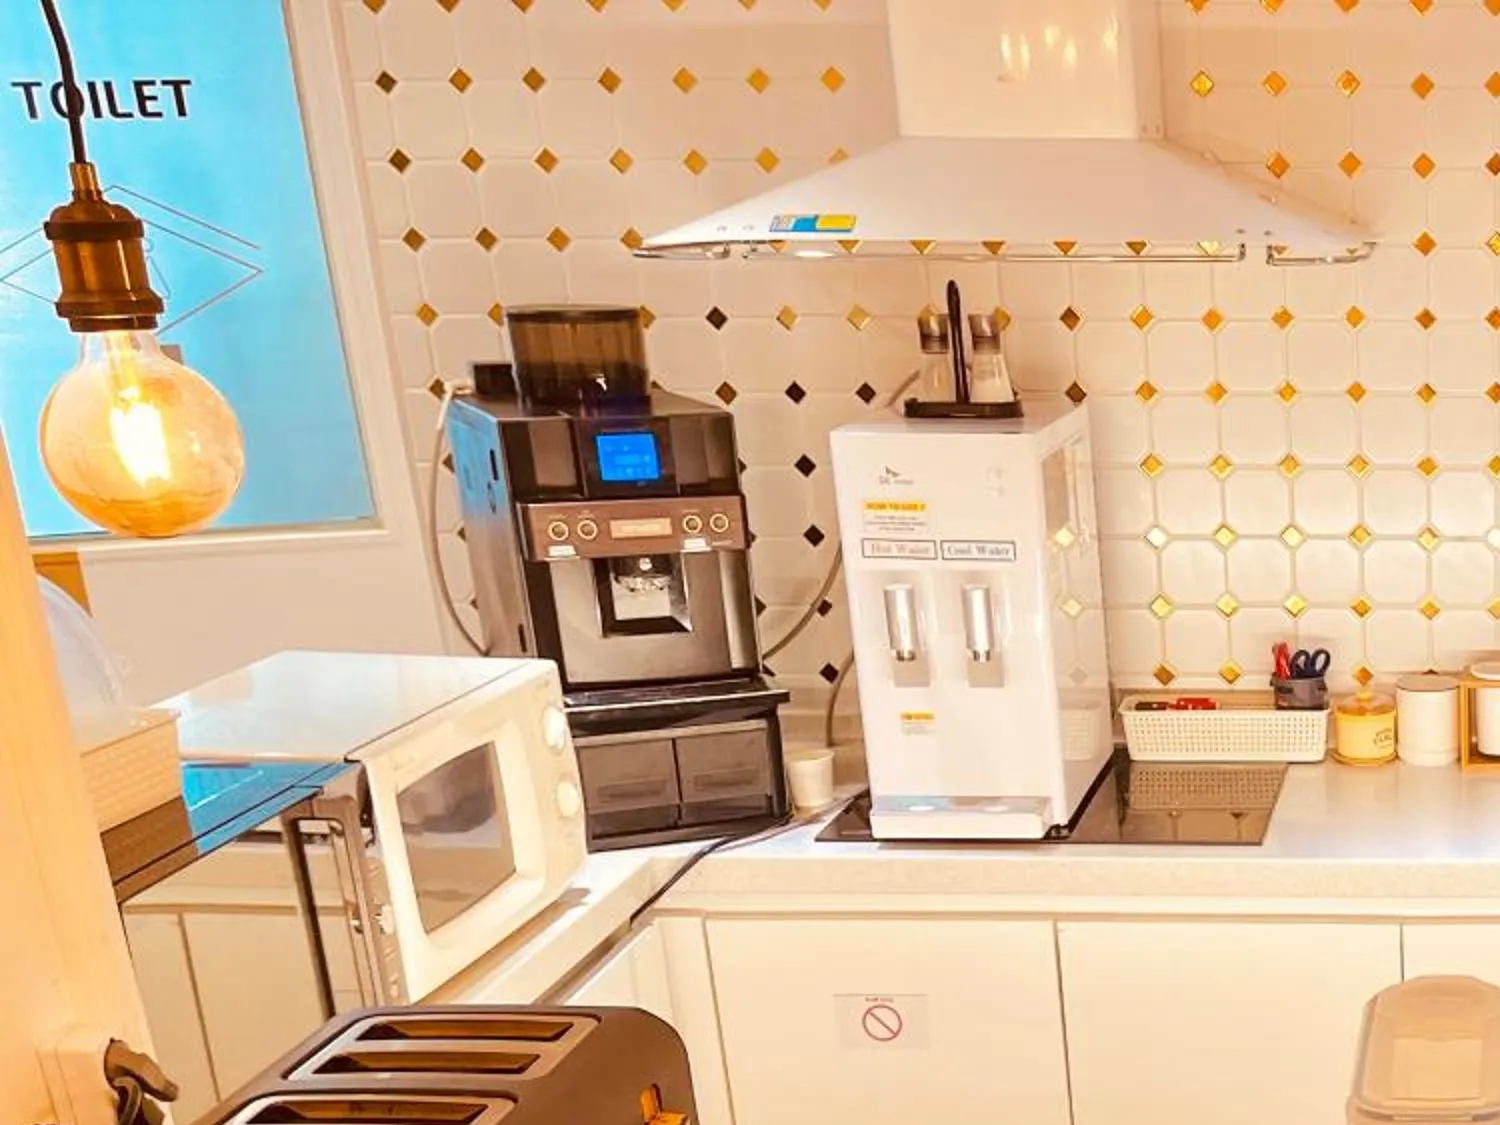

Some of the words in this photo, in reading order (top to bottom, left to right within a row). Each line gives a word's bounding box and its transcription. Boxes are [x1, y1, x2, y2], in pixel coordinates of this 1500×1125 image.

[10, 79, 192, 120] TOILET
[870, 542, 892, 555] Hot
[895, 543, 930, 556] Water
[976, 545, 1010, 557] Water
